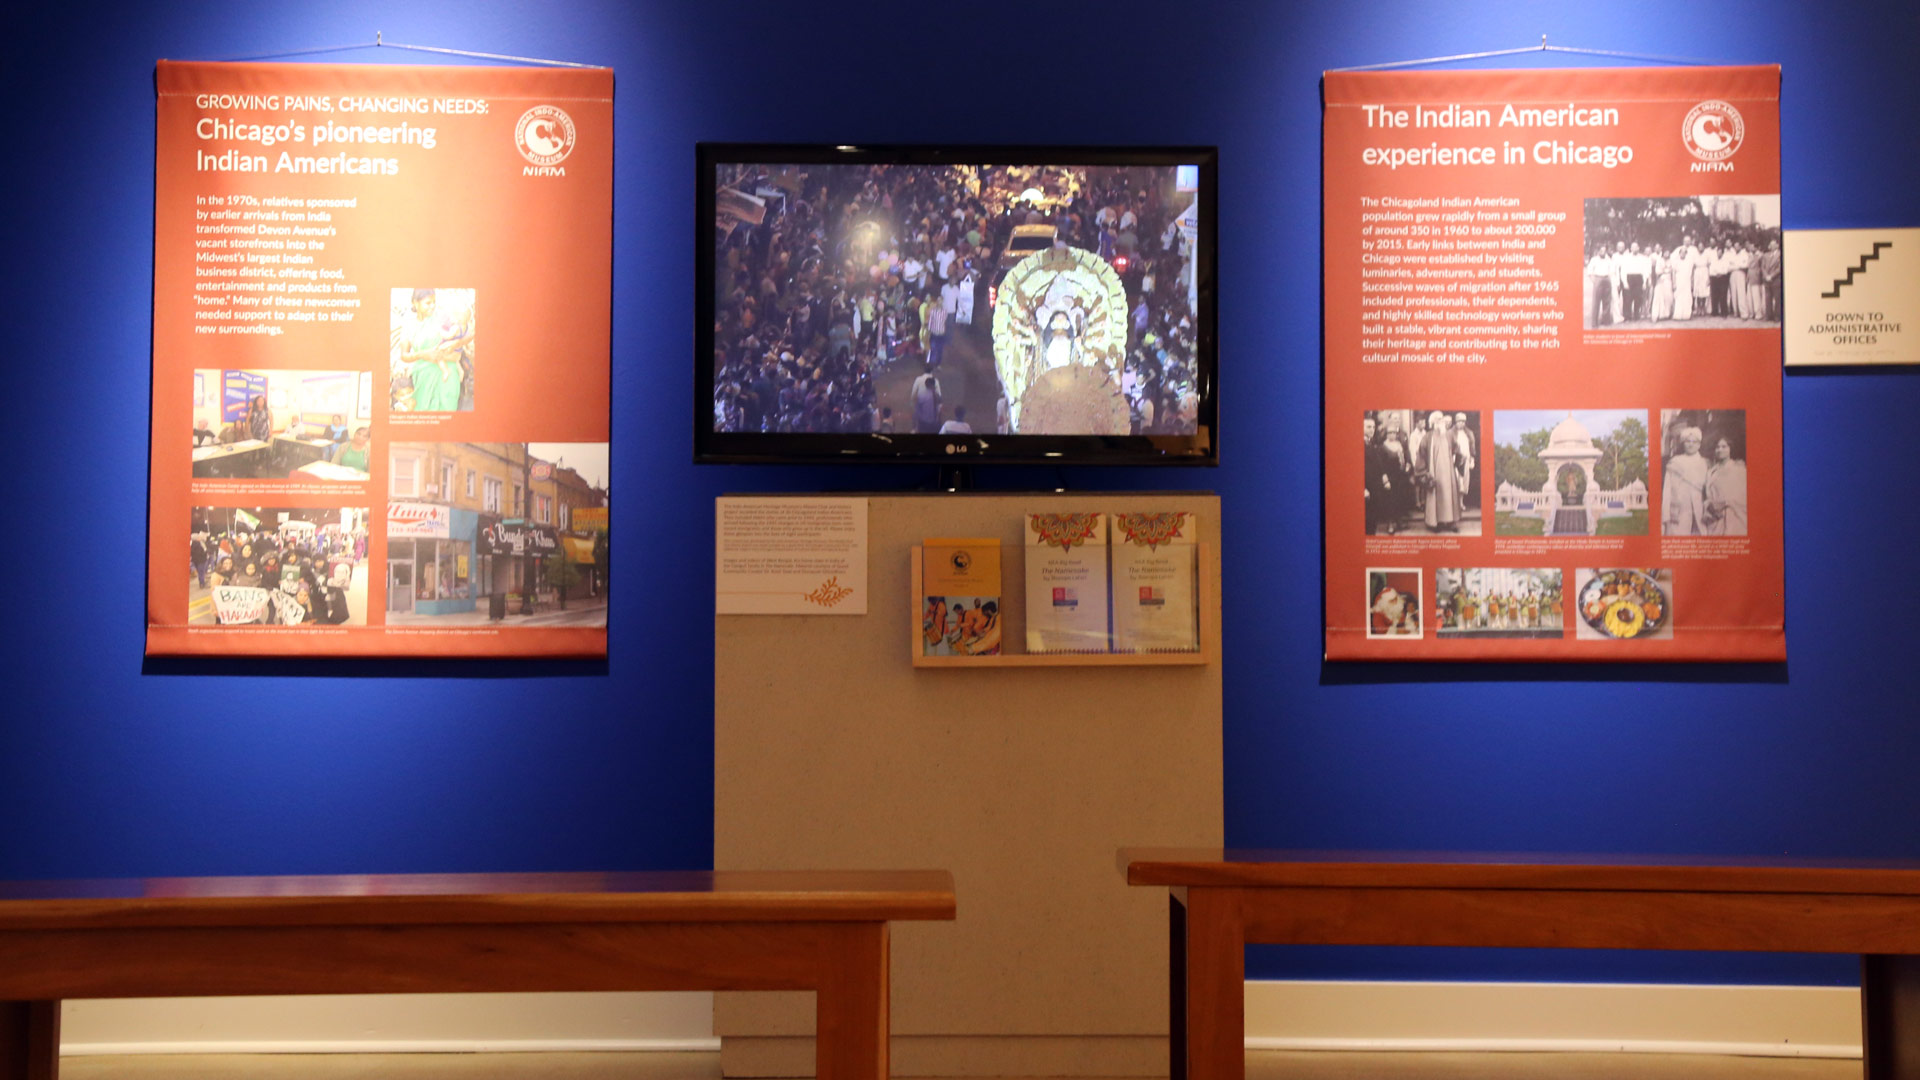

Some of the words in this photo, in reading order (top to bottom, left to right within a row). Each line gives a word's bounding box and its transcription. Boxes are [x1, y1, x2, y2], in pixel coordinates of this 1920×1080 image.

[196, 94, 279, 110] GROWING
[284, 95, 334, 112] PAINS,
[338, 97, 428, 113] CHANGING
[433, 98, 488, 114] NEEDS:
[1361, 104, 1409, 128] The
[1415, 103, 1490, 127] Indian
[1497, 103, 1618, 127] American
[196, 118, 304, 145] Chicago's
[313, 121, 435, 148] pioneering
[527, 151, 564, 164] MUSEUM
[1362, 143, 1496, 168] experience
[1502, 141, 1525, 164] in
[1532, 140, 1633, 167] Chicago
[1695, 146, 1732, 159] MUSEUM
[197, 150, 267, 172] Indian
[275, 152, 398, 175] Americans
[1690, 161, 1735, 173] NIAM
[523, 165, 566, 177] NIAM
[196, 194, 205, 205] In
[207, 194, 224, 205] the
[226, 194, 260, 206] 1970s,
[262, 196, 304, 207] relatives
[306, 197, 356, 208] sponsored
[1360, 196, 1379, 207] The
[1381, 196, 1439, 208] Chicagoland
[1441, 196, 1471, 207] Indian
[1473, 196, 1519, 207] American
[196, 209, 208, 221] by
[210, 209, 240, 219] earlier
[242, 210, 278, 220] arrivals
[281, 210, 305, 221] from
[307, 211, 331, 222] India
[1362, 211, 1413, 222] population
[1415, 213, 1439, 223] grew
[1441, 210, 1474, 222] rapidly
[1476, 210, 1500, 221] from
[1502, 211, 1508, 221] a
[1510, 210, 1535, 220] small
[1537, 212, 1566, 222] group
[196, 224, 255, 234] transformed
[257, 224, 290, 235] Devon
[292, 225, 336, 236] Avenue's
[1362, 224, 1373, 235] of
[1374, 225, 1408, 236] around
[1410, 225, 1430, 236] 350
[1431, 225, 1441, 235] in
[1443, 225, 1469, 236] 1960
[1470, 225, 1482, 235] to
[1483, 224, 1512, 235] about
[1514, 223, 1556, 235] 200,000
[195, 239, 226, 248] vacant
[229, 238, 284, 249] storefronts
[286, 239, 306, 250] into
[307, 239, 324, 250] the
[1362, 239, 1374, 251] by
[1377, 238, 1404, 250] 2015.
[1406, 239, 1430, 251] Early
[1432, 239, 1454, 250] links
[1456, 240, 1499, 250] between
[1501, 238, 1525, 249] India
[1527, 238, 1545, 249] and
[196, 252, 244, 262] Midwest's
[247, 253, 280, 264] largest
[282, 253, 313, 264] Indian
[1362, 253, 1400, 265] Chicago
[1403, 255, 1426, 264] were
[1428, 253, 1482, 264] established
[1485, 253, 1497, 264] by
[1499, 252, 1534, 265] visiting
[195, 266, 236, 277] business
[239, 266, 275, 277] district,
[278, 267, 317, 280] offering
[319, 268, 344, 279] food,
[1362, 267, 1413, 278] luminaries,
[1415, 268, 1475, 278] adventurers,
[1477, 267, 1496, 278] and
[1498, 267, 1542, 278] students.
[195, 281, 264, 291] entertainment
[266, 281, 285, 292] and
[287, 282, 331, 293] products
[333, 282, 357, 293] from
[1362, 281, 1413, 292] Successive
[1415, 283, 1445, 292] waves
[1446, 281, 1457, 292] of
[1459, 281, 1506, 294] migration
[1508, 281, 1531, 292] after
[1534, 280, 1559, 292] 1965
[193, 295, 230, 305] "home."
[232, 295, 260, 306] Many
[261, 295, 272, 306] of
[274, 296, 302, 307] these
[304, 298, 360, 307] newcomers
[1362, 295, 1403, 306] included
[1405, 296, 1469, 307] professionals,
[1472, 295, 1494, 306] their
[1497, 295, 1556, 307] dependents,
[195, 309, 231, 319] needed
[234, 309, 271, 322] support
[273, 310, 284, 320] to
[287, 310, 315, 322] adapt
[317, 311, 328, 321] to
[330, 311, 353, 321] their
[1362, 310, 1380, 320] and
[1382, 309, 1411, 322] highly
[1413, 309, 1443, 320] skilled
[1445, 310, 1499, 322] technology
[1501, 309, 1540, 320] workers
[1542, 309, 1564, 320] who
[1826, 313, 1864, 322] DOWN
[1868, 312, 1884, 321] TO
[195, 325, 216, 334] new
[218, 324, 283, 336] surroundings.
[1362, 323, 1384, 334] built
[1386, 325, 1392, 335] a
[1394, 323, 1426, 335] stable,
[1427, 324, 1461, 335] vibrant
[1463, 324, 1520, 335] community,
[1522, 323, 1558, 336] sharing
[1808, 323, 1902, 334] ADMINISTRATIVE
[1362, 338, 1384, 348] their
[1387, 338, 1426, 350] heritage
[1428, 338, 1446, 349] and
[1448, 338, 1507, 350] contributing
[1509, 338, 1520, 348] to
[1522, 338, 1539, 349] the
[1541, 337, 1560, 349] rich
[1833, 335, 1877, 344] OFFICES
[1362, 352, 1398, 363] cultural
[1401, 352, 1433, 363] mosaic
[1436, 351, 1446, 363] of
[1448, 352, 1464, 363] the
[1466, 352, 1486, 364] city.
[957, 445, 967, 453] LG
[220, 590, 264, 602] BANS
